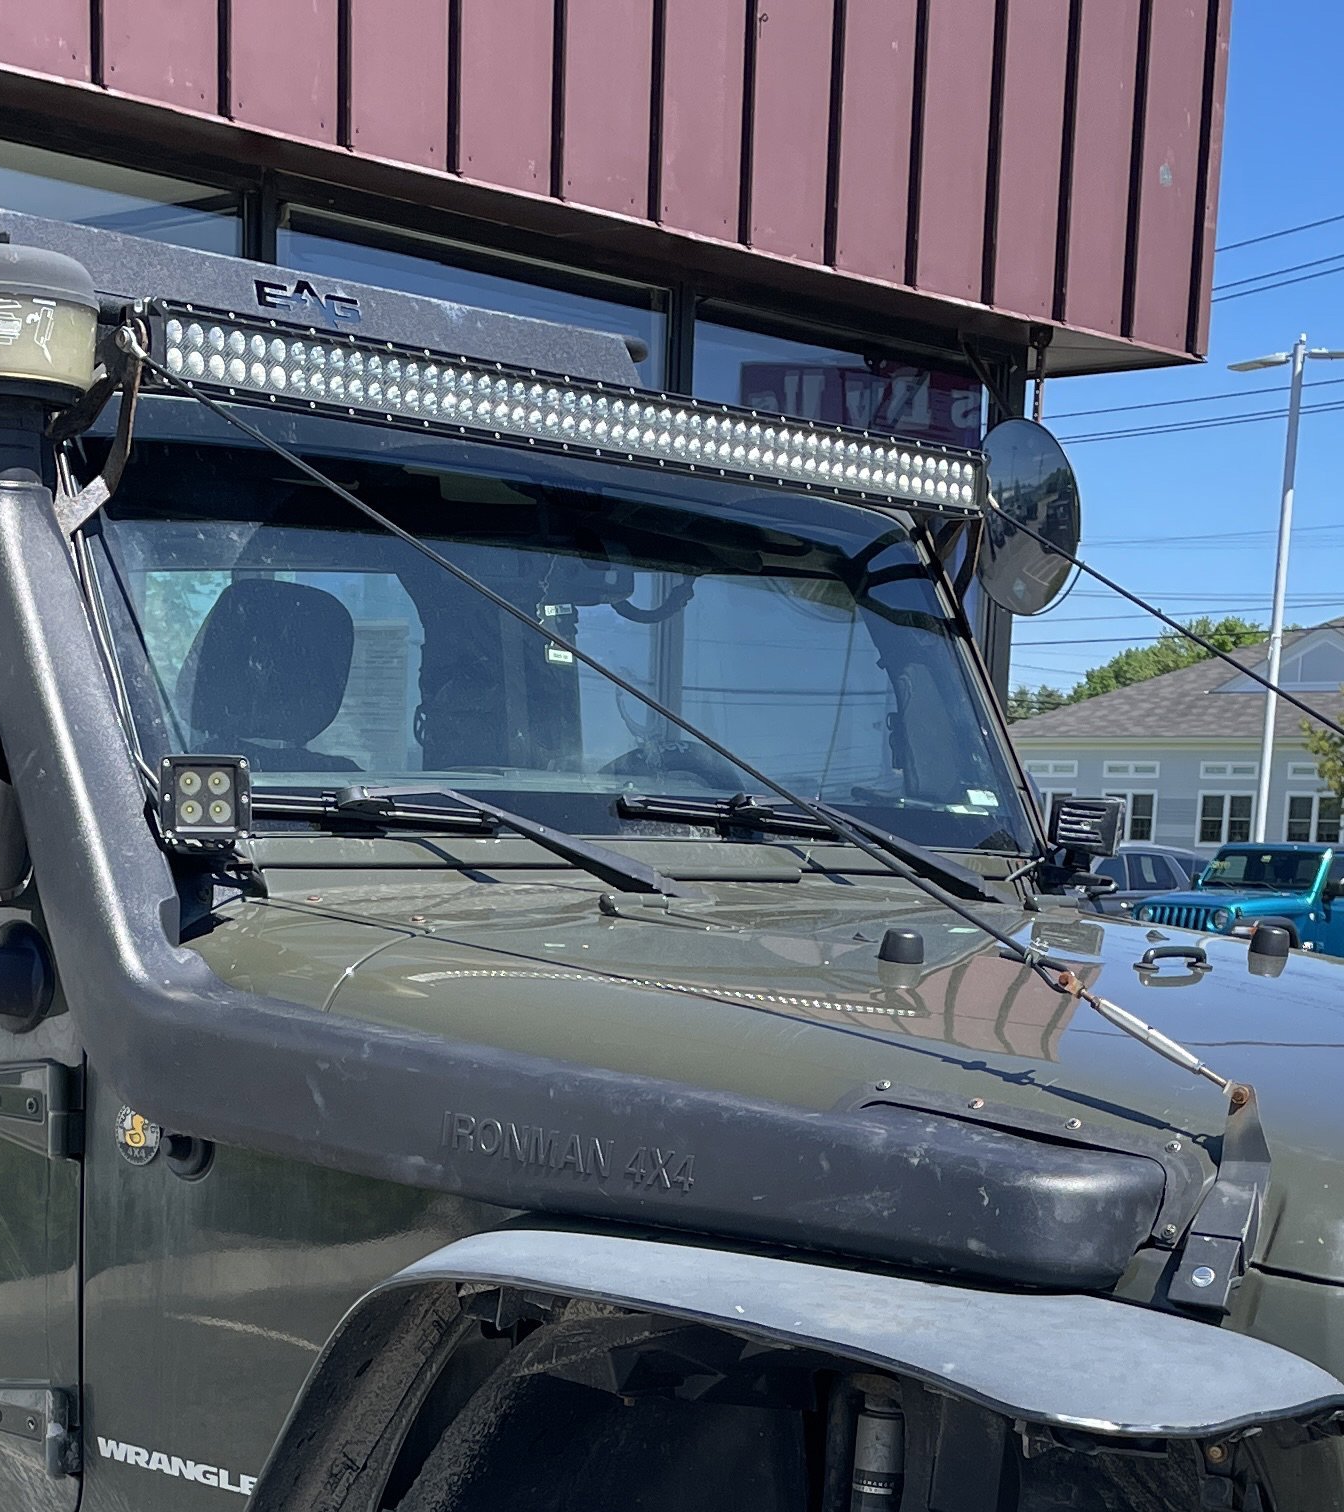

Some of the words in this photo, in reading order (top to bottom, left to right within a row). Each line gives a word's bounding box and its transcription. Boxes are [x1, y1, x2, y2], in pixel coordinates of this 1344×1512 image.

[441, 1111, 615, 1178] IRONMAN
[623, 1146, 696, 1192] 4X4
[97, 1436, 258, 1496] WRANGLE
